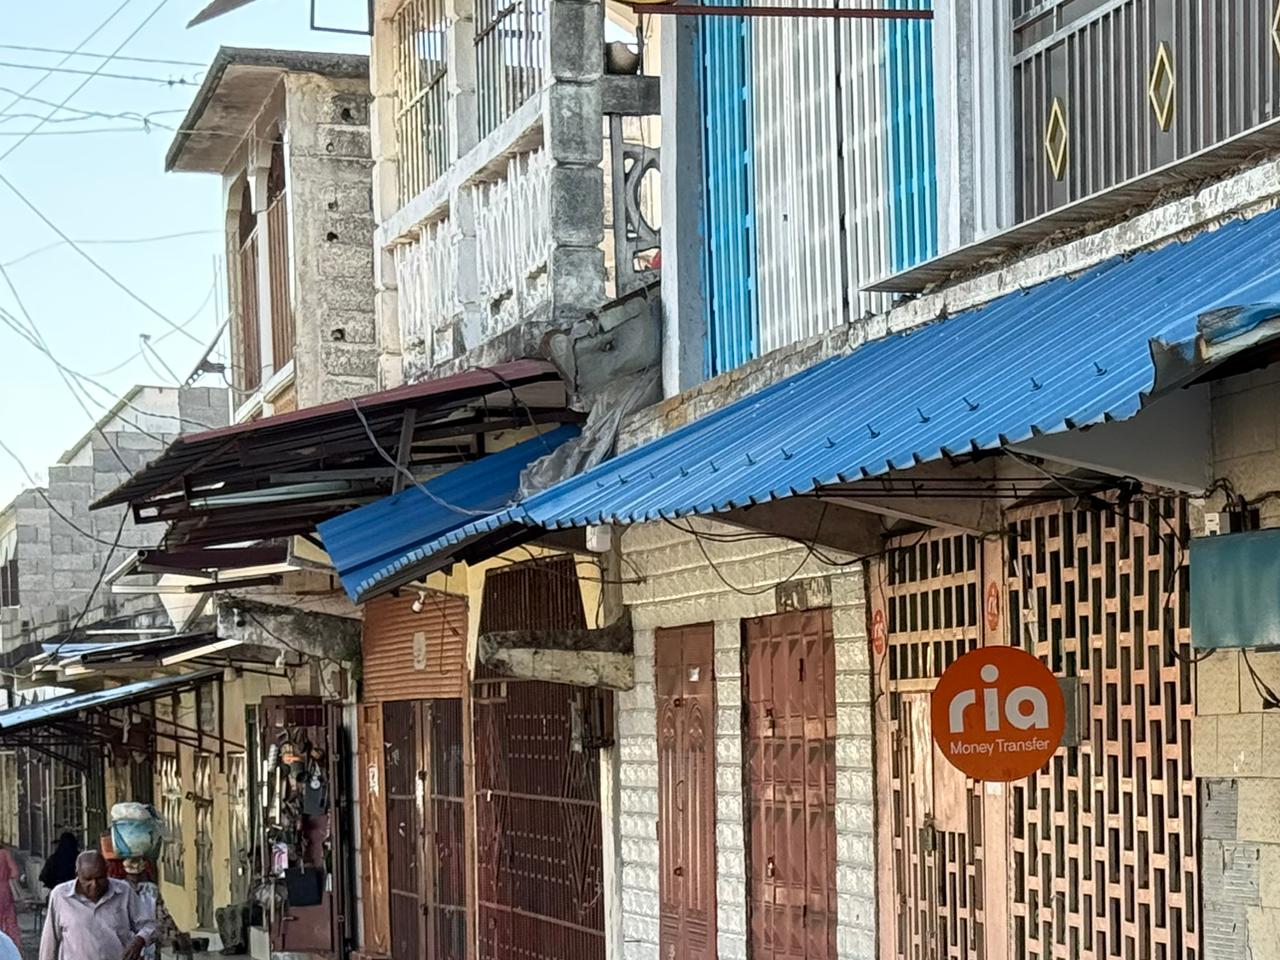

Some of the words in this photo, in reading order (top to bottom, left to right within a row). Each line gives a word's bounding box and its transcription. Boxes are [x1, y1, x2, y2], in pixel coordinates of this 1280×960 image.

[949, 664, 1049, 734] ria
[950, 740, 994, 755] Money
[996, 737, 1050, 753] Transfer
